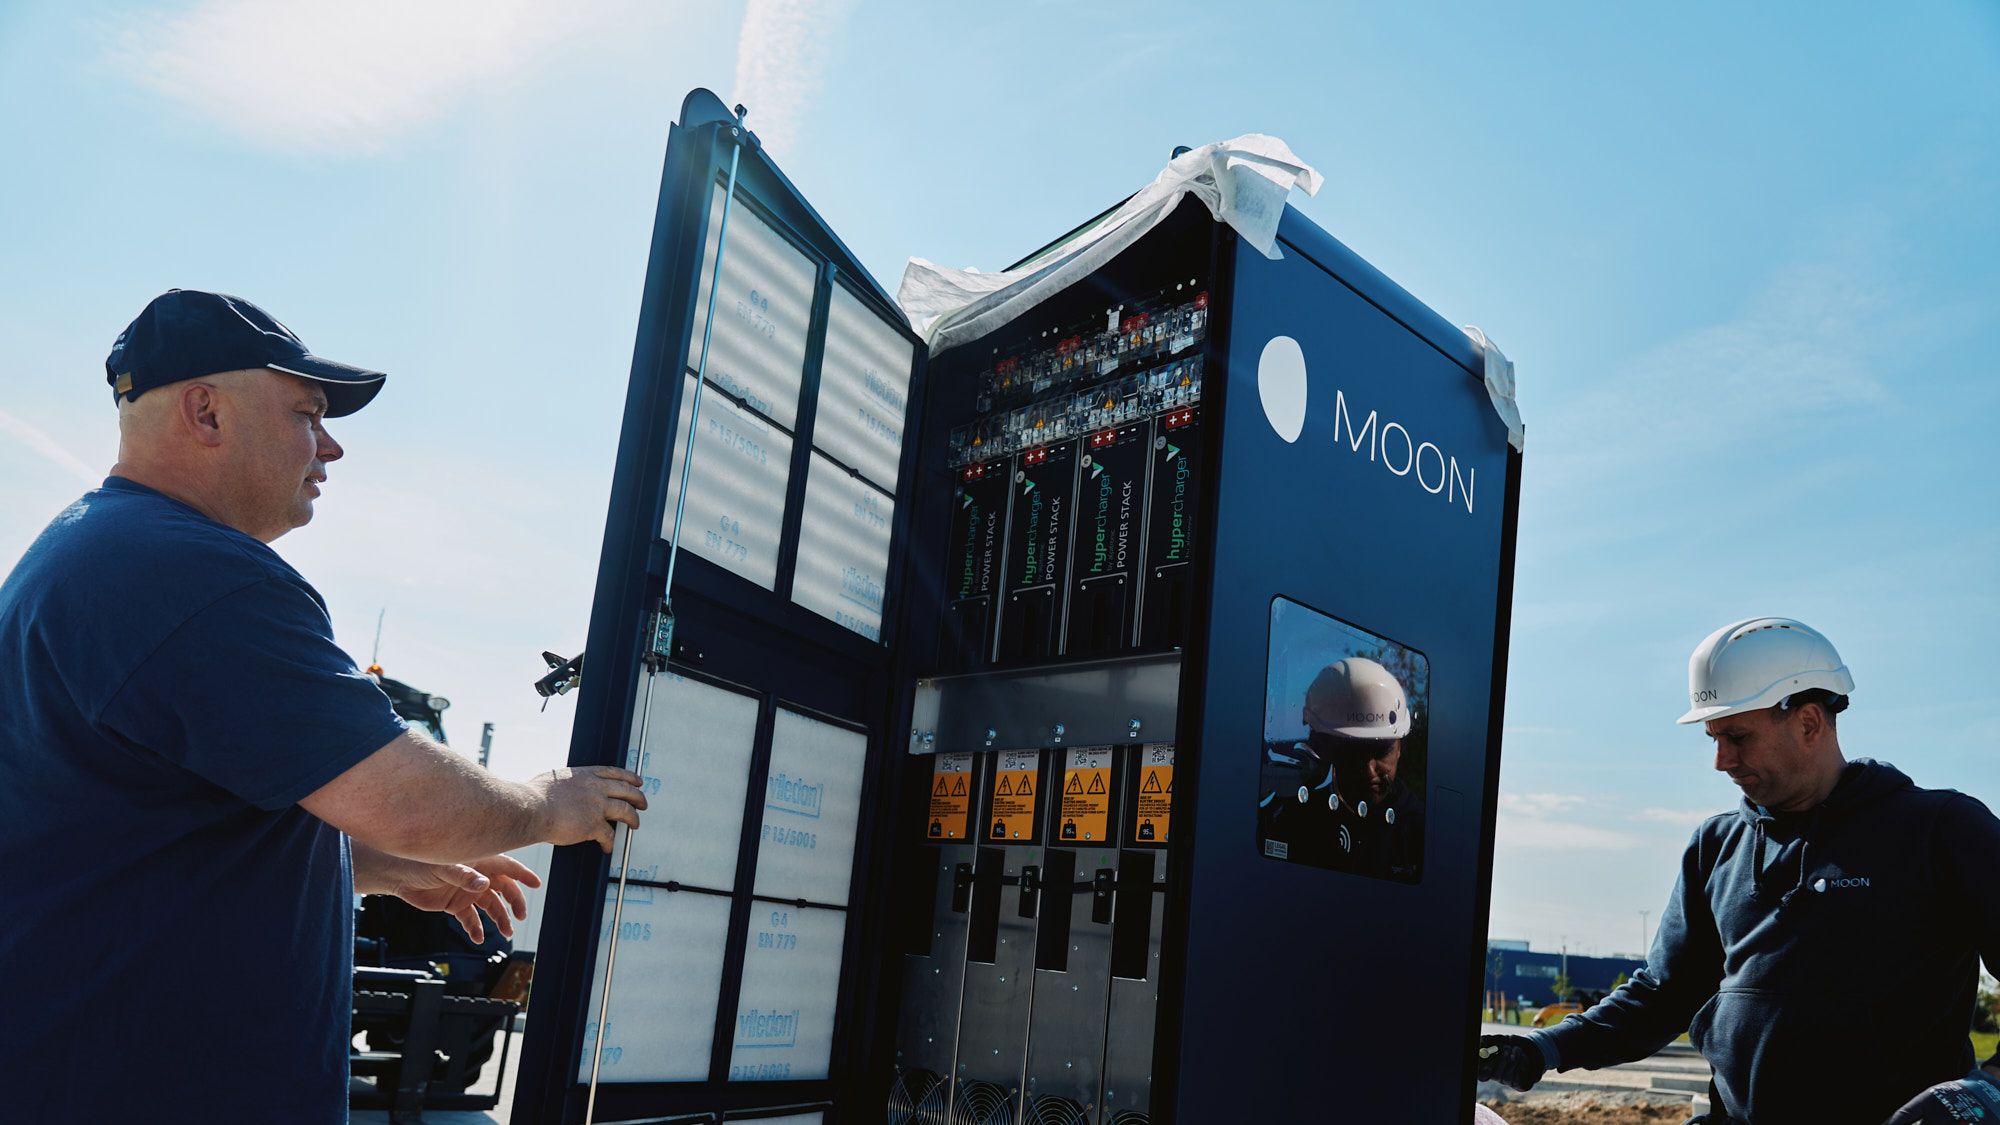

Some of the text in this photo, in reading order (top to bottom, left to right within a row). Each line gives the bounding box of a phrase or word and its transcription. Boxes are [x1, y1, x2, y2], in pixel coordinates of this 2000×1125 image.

[1333, 389, 1475, 515] MOON
[1022, 490, 1044, 584] hypercharger
[1045, 496, 1061, 581] POWER STACK
[1089, 473, 1112, 573] hypercharger
[1116, 480, 1132, 569] POWER STACK
[1167, 455, 1189, 559] hypercharger
[981, 510, 997, 592] POWER STACK
[1693, 689, 1717, 702] OON
[1831, 877, 1871, 889] MOON
[758, 932, 797, 950] EN 779
[739, 1009, 793, 1038] viledon
